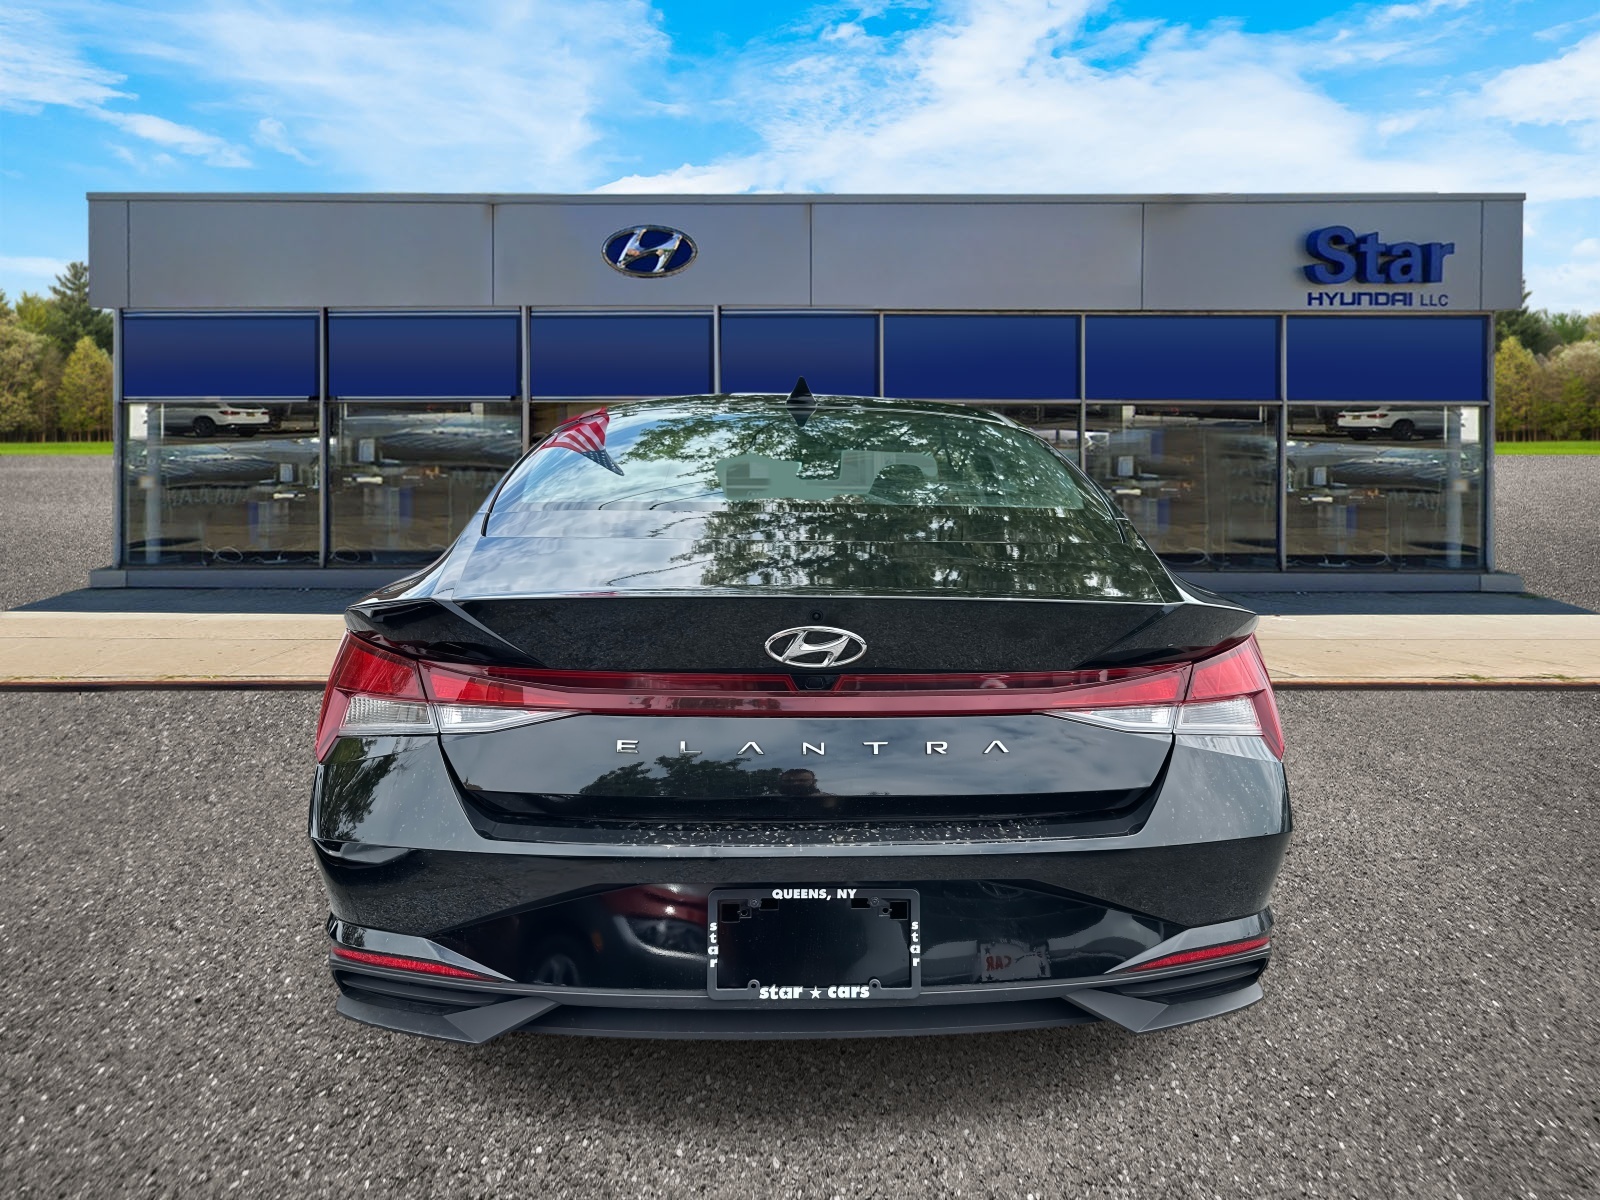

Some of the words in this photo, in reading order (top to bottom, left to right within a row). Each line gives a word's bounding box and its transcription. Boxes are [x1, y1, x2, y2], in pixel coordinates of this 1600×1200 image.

[1303, 225, 1455, 285] Star
[1307, 292, 1413, 306] HYUNDAI
[1420, 294, 1449, 307] LLC
[616, 739, 1010, 755] ELANTRA
[772, 889, 832, 901] QUEENS,
[836, 889, 858, 899] NY
[759, 984, 804, 1000] star
[827, 984, 870, 999] cars
